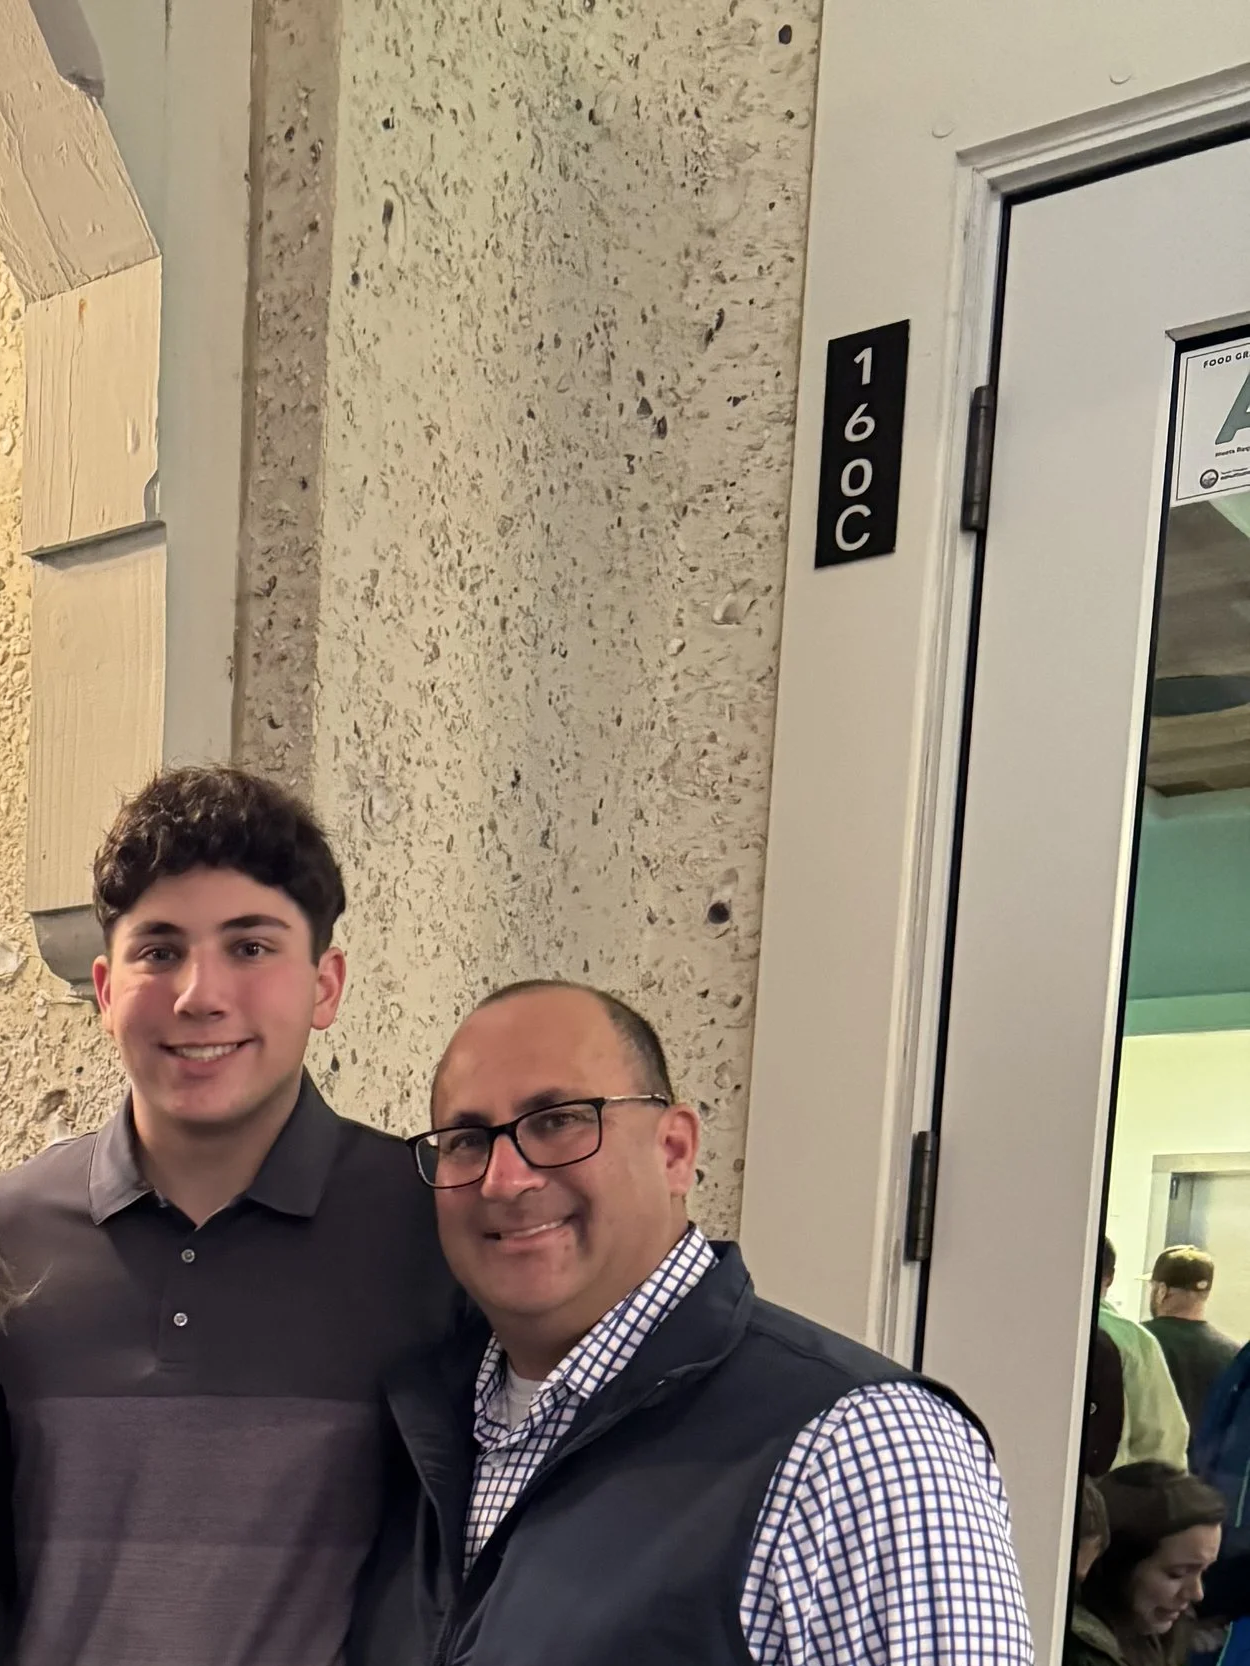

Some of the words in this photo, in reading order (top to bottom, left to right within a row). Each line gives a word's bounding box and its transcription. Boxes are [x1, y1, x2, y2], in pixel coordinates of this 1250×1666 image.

[1203, 354, 1232, 369] FOOD
[1235, 350, 1250, 361] GR
[835, 346, 876, 552] 160C
